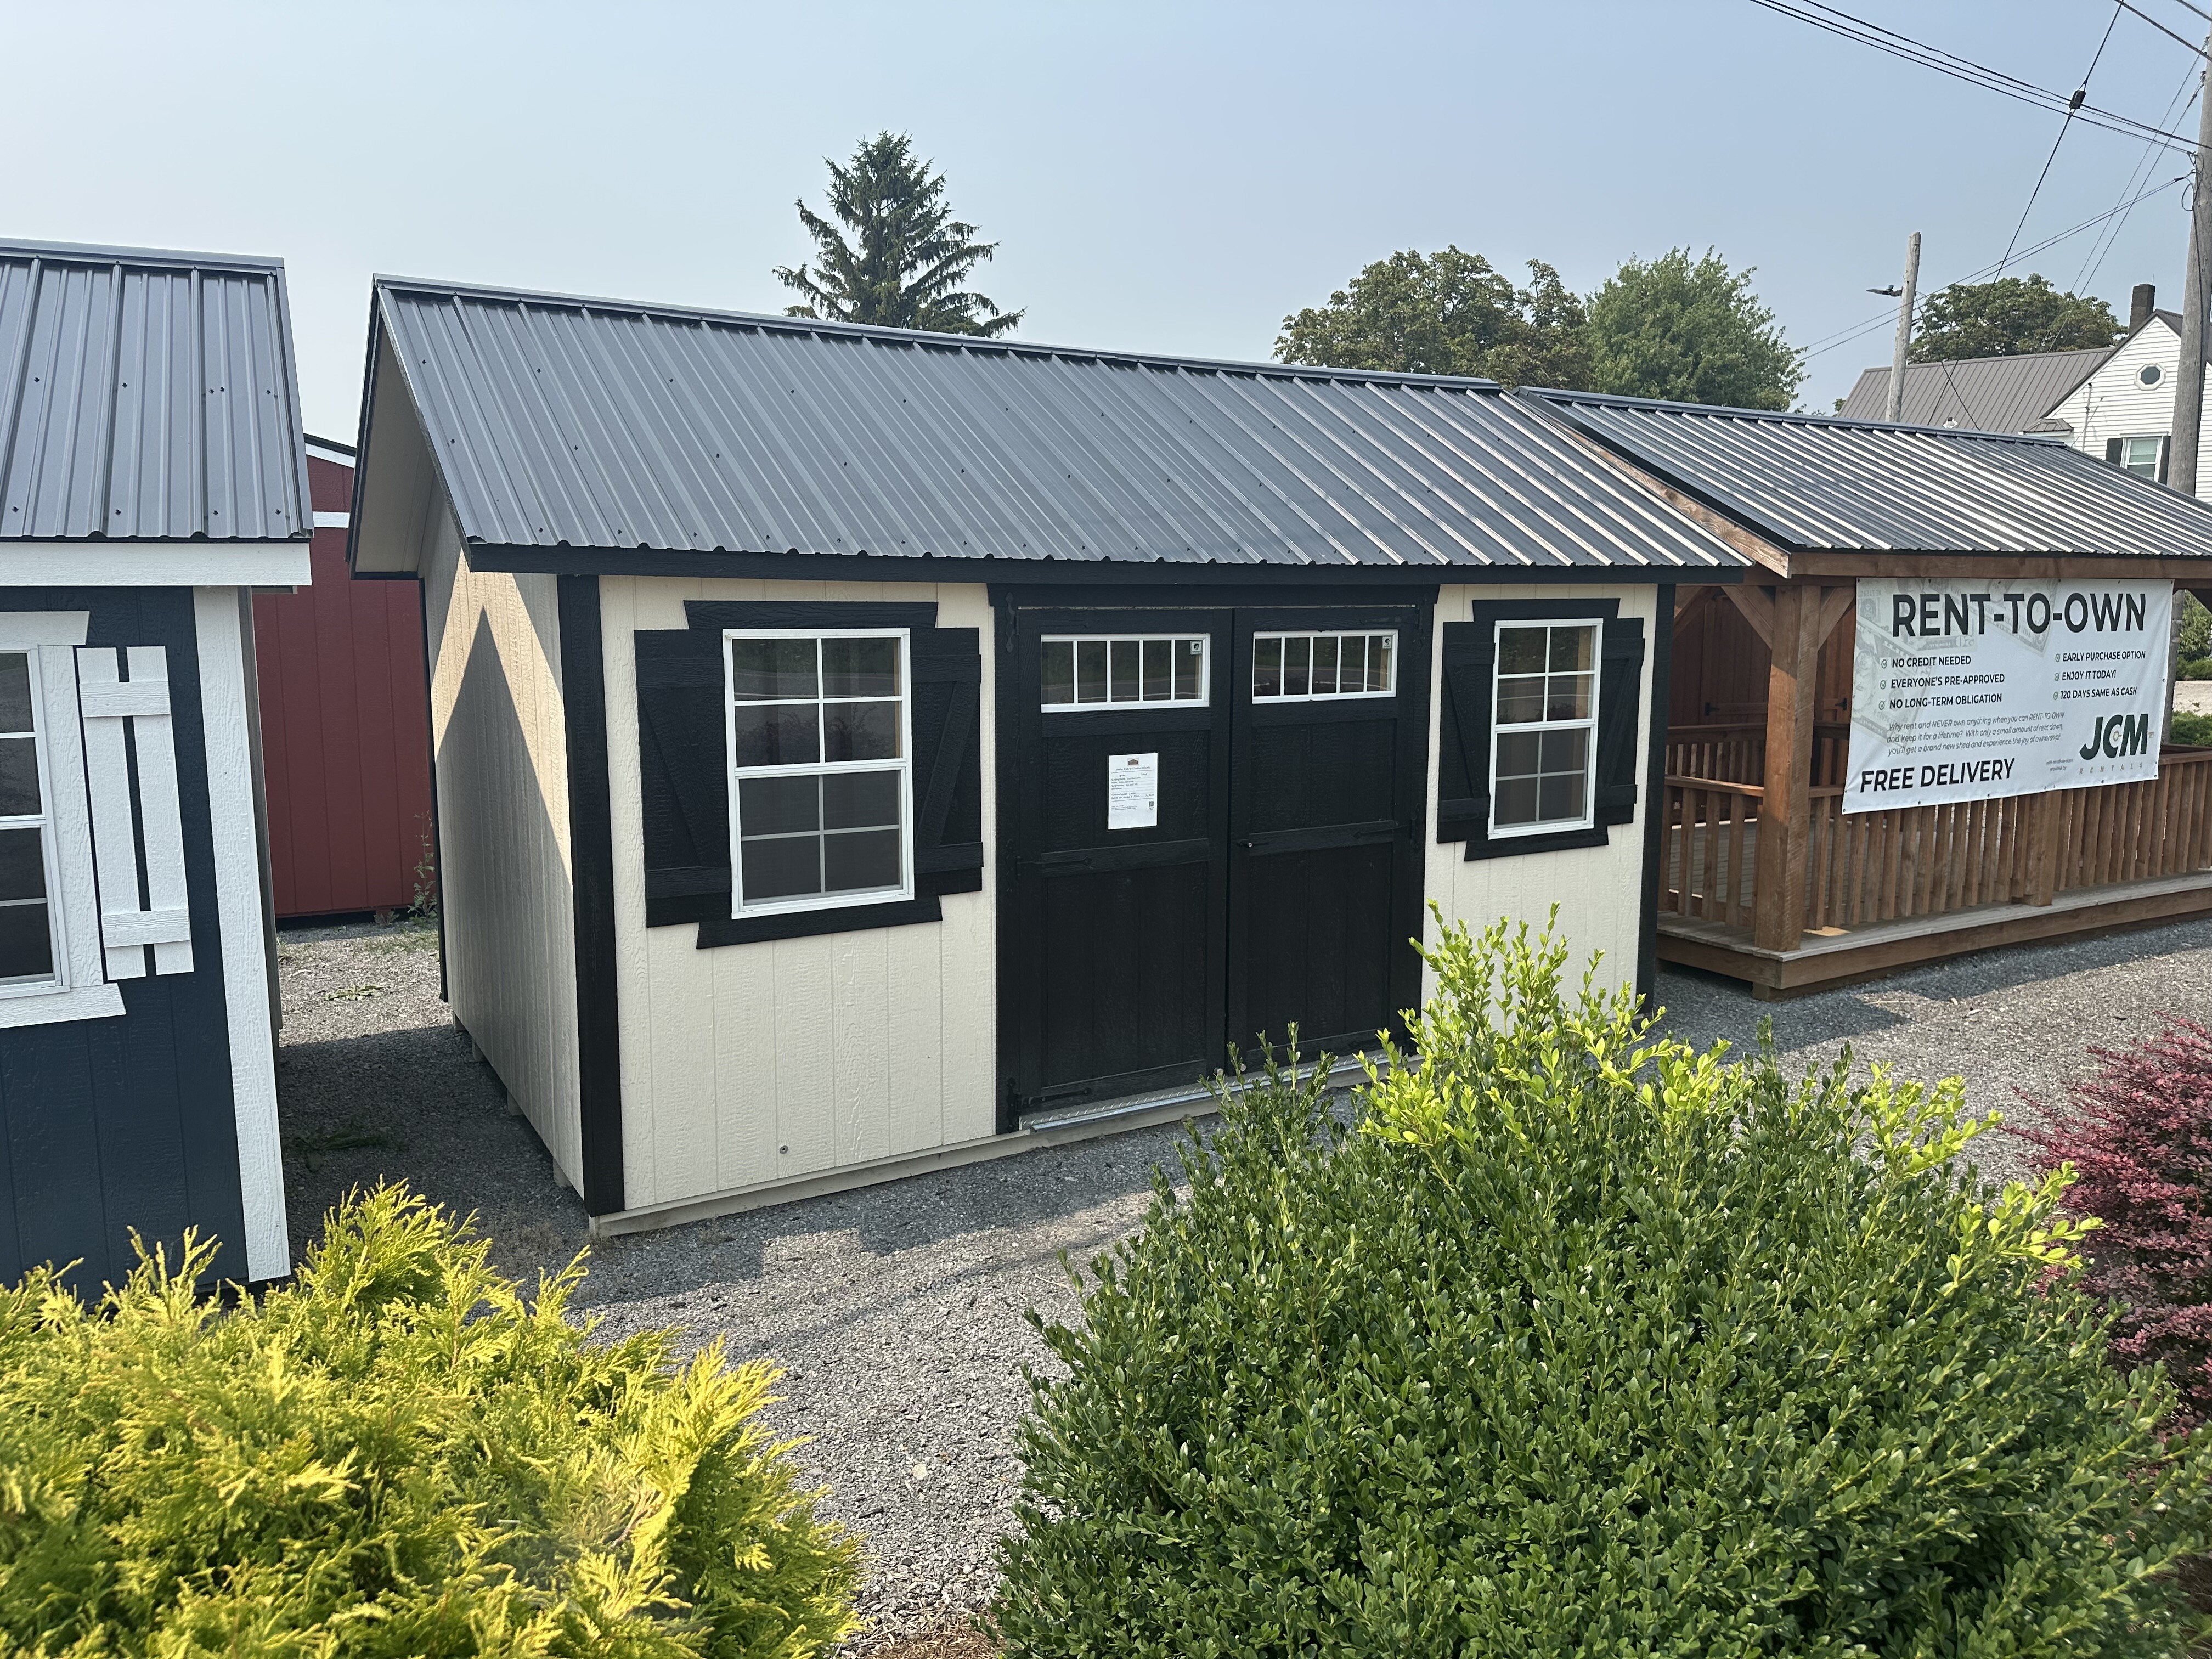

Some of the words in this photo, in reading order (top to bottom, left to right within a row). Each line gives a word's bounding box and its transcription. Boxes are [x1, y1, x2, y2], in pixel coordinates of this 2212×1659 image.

[1893, 592, 2146, 637] RENT-TO-OWN
[1892, 658, 1905, 668] NO
[1906, 657, 1937, 667] CREDIT
[1938, 656, 1971, 666] NEEDED
[2063, 652, 2085, 662] EARLY
[2086, 651, 2120, 661] PURCHASE
[2122, 651, 2146, 659] OPTION
[1891, 676, 1942, 689] EVERYONE'S
[1944, 674, 2005, 686] PRE-APPROVED
[2062, 672, 2084, 680] ENJOY
[2085, 670, 2092, 679] IT
[2093, 670, 2117, 679] TODAY!
[2061, 690, 2070, 699] 120
[2072, 689, 2090, 698] DAYS
[2092, 688, 2109, 698] SAME
[2111, 687, 2120, 696] AS
[2121, 686, 2137, 696] CASH
[1889, 699, 1903, 709] NO
[1905, 696, 1953, 708] LONG-TERM
[1955, 693, 2002, 705] OBLIGATION
[1889, 723, 1903, 732] Why
[1918, 720, 1931, 729] and
[1932, 719, 1953, 727] NEVER
[1966, 717, 1991, 726] anything
[2007, 716, 2018, 724] you
[2029, 712, 2065, 720] RENT-TO-OWN
[1887, 735, 1899, 743] and
[1901, 734, 1916, 743] keep
[1917, 732, 1922, 741] it
[1923, 732, 1932, 740] for
[1938, 730, 1963, 739] lifetime?
[1966, 729, 1979, 737] With
[1980, 728, 1992, 737] only
[1997, 726, 2012, 735] small
[2079, 714, 2148, 760] JCM
[1906, 746, 1917, 755] get
[1923, 743, 1942, 752] brand
[1956, 740, 1970, 749] shed
[1983, 738, 2012, 748] experience
[2021, 736, 2029, 746] joy
[1860, 767, 1915, 793] FREE
[1920, 758, 2015, 788] DELIVERY
[2079, 762, 2142, 775] RENTALS
